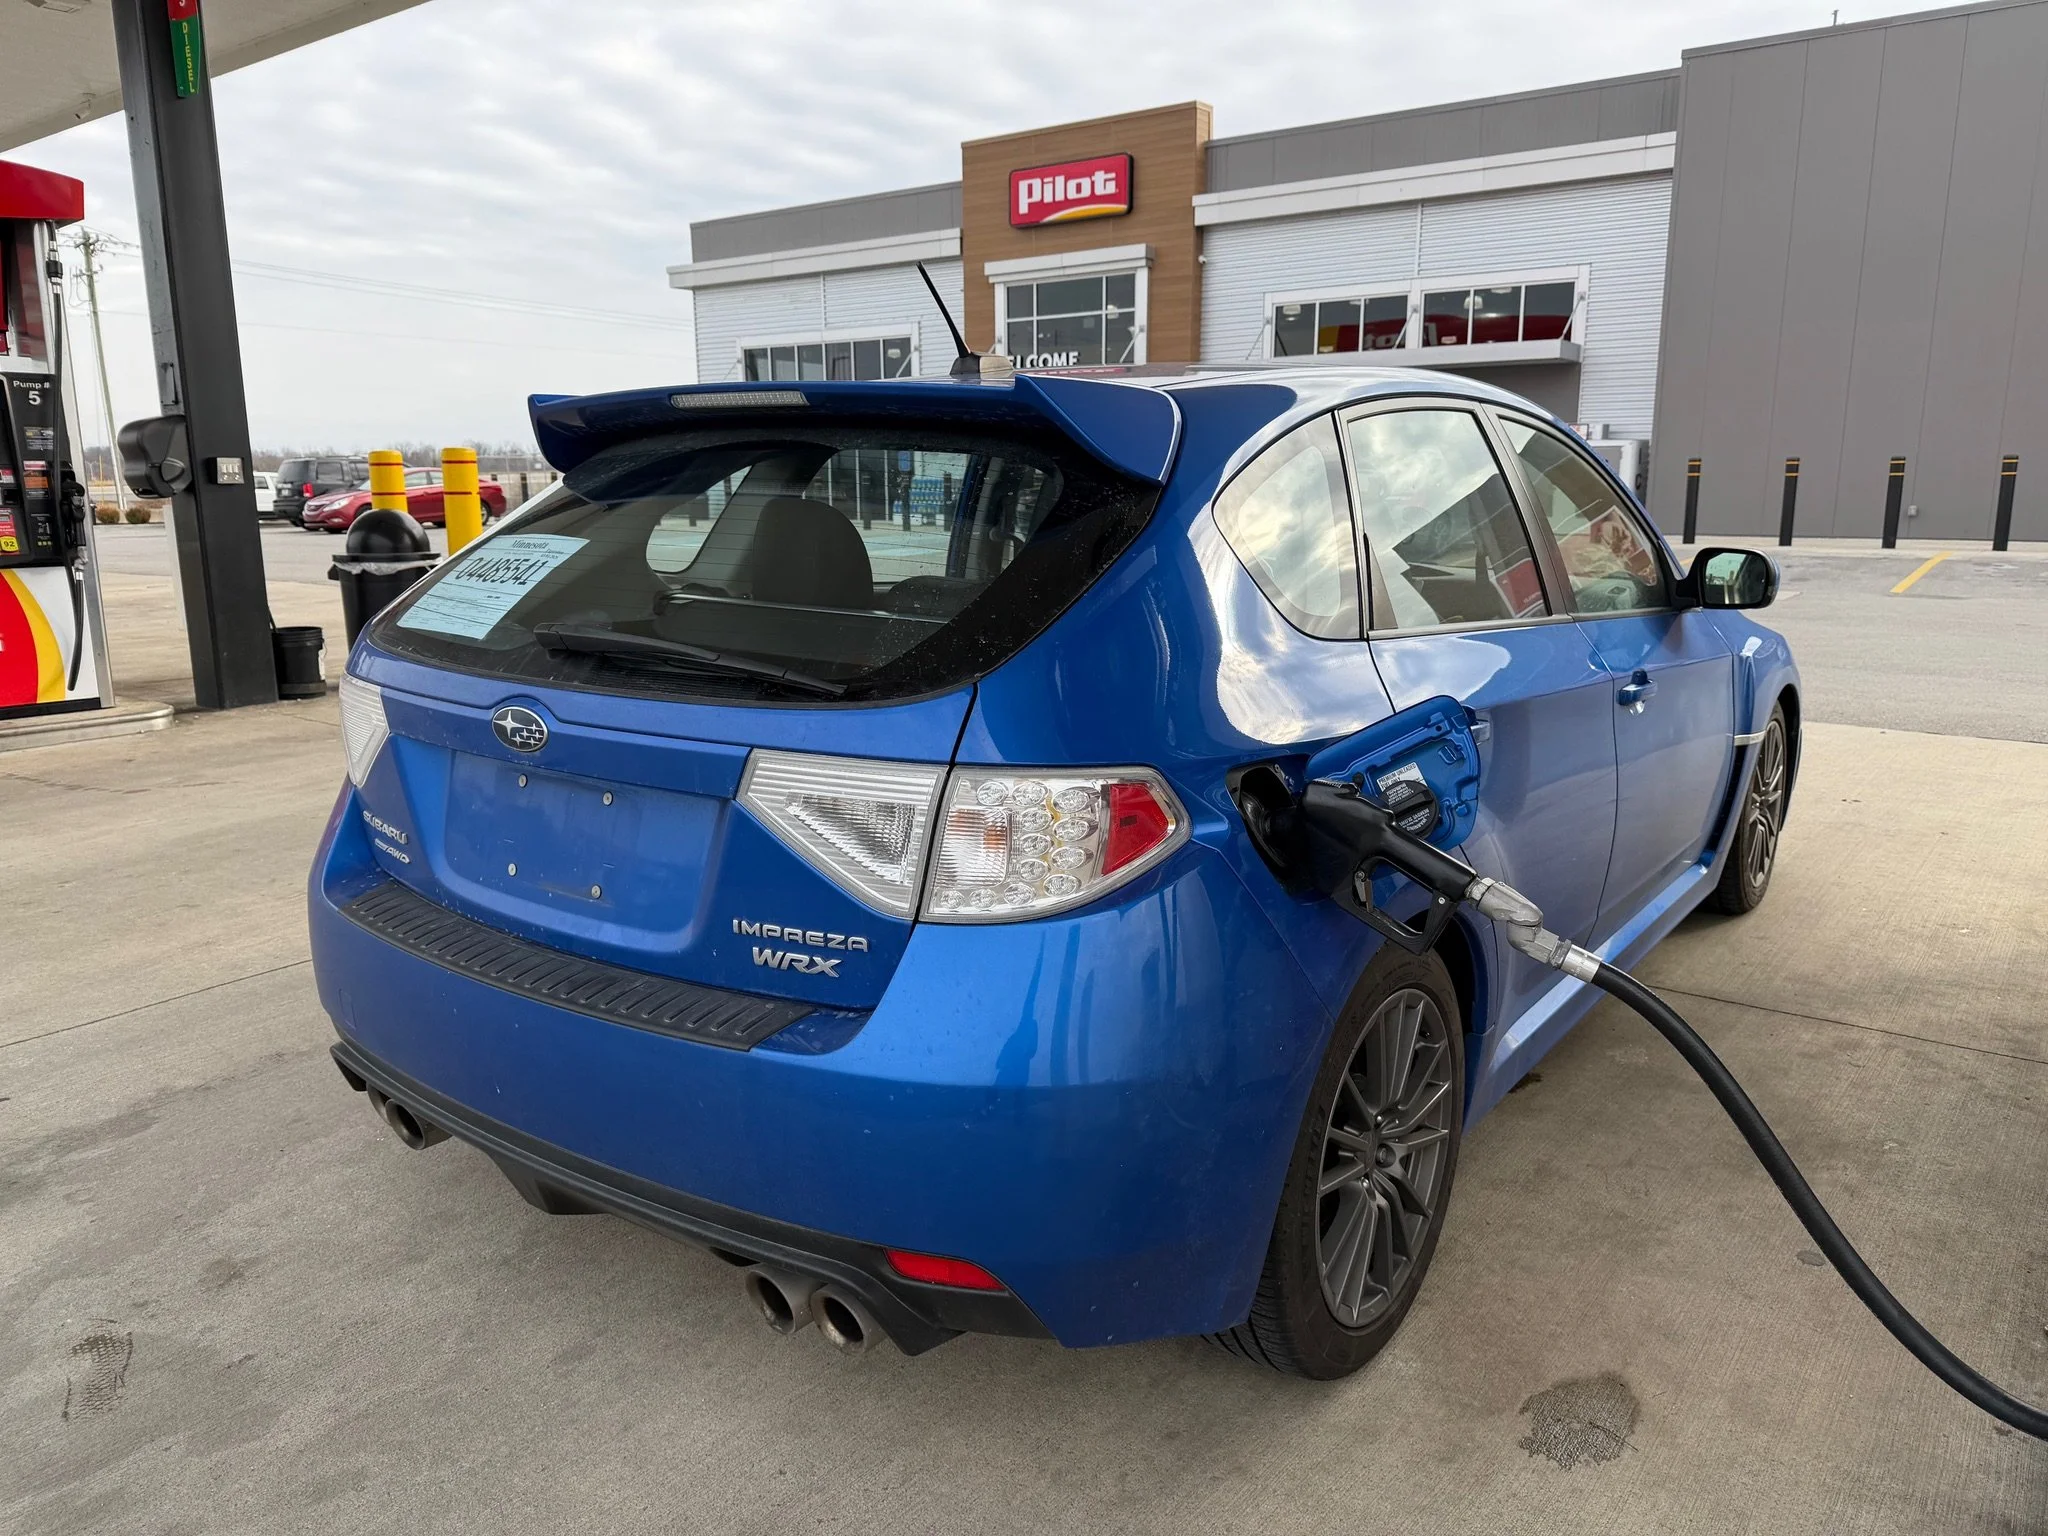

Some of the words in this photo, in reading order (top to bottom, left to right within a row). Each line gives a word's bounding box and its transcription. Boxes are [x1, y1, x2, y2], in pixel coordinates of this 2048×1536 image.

[182, 22, 195, 93] DIESEL
[1018, 170, 1116, 215] Pilot
[1007, 352, 1079, 369] ELCOME
[13, 380, 42, 389] Pump
[28, 390, 41, 405] 5
[512, 540, 550, 549] Minnesota
[455, 557, 548, 586] 04485541
[363, 810, 408, 844] SUBARU
[732, 919, 869, 953] IMPREZA
[752, 946, 842, 978] WRX
